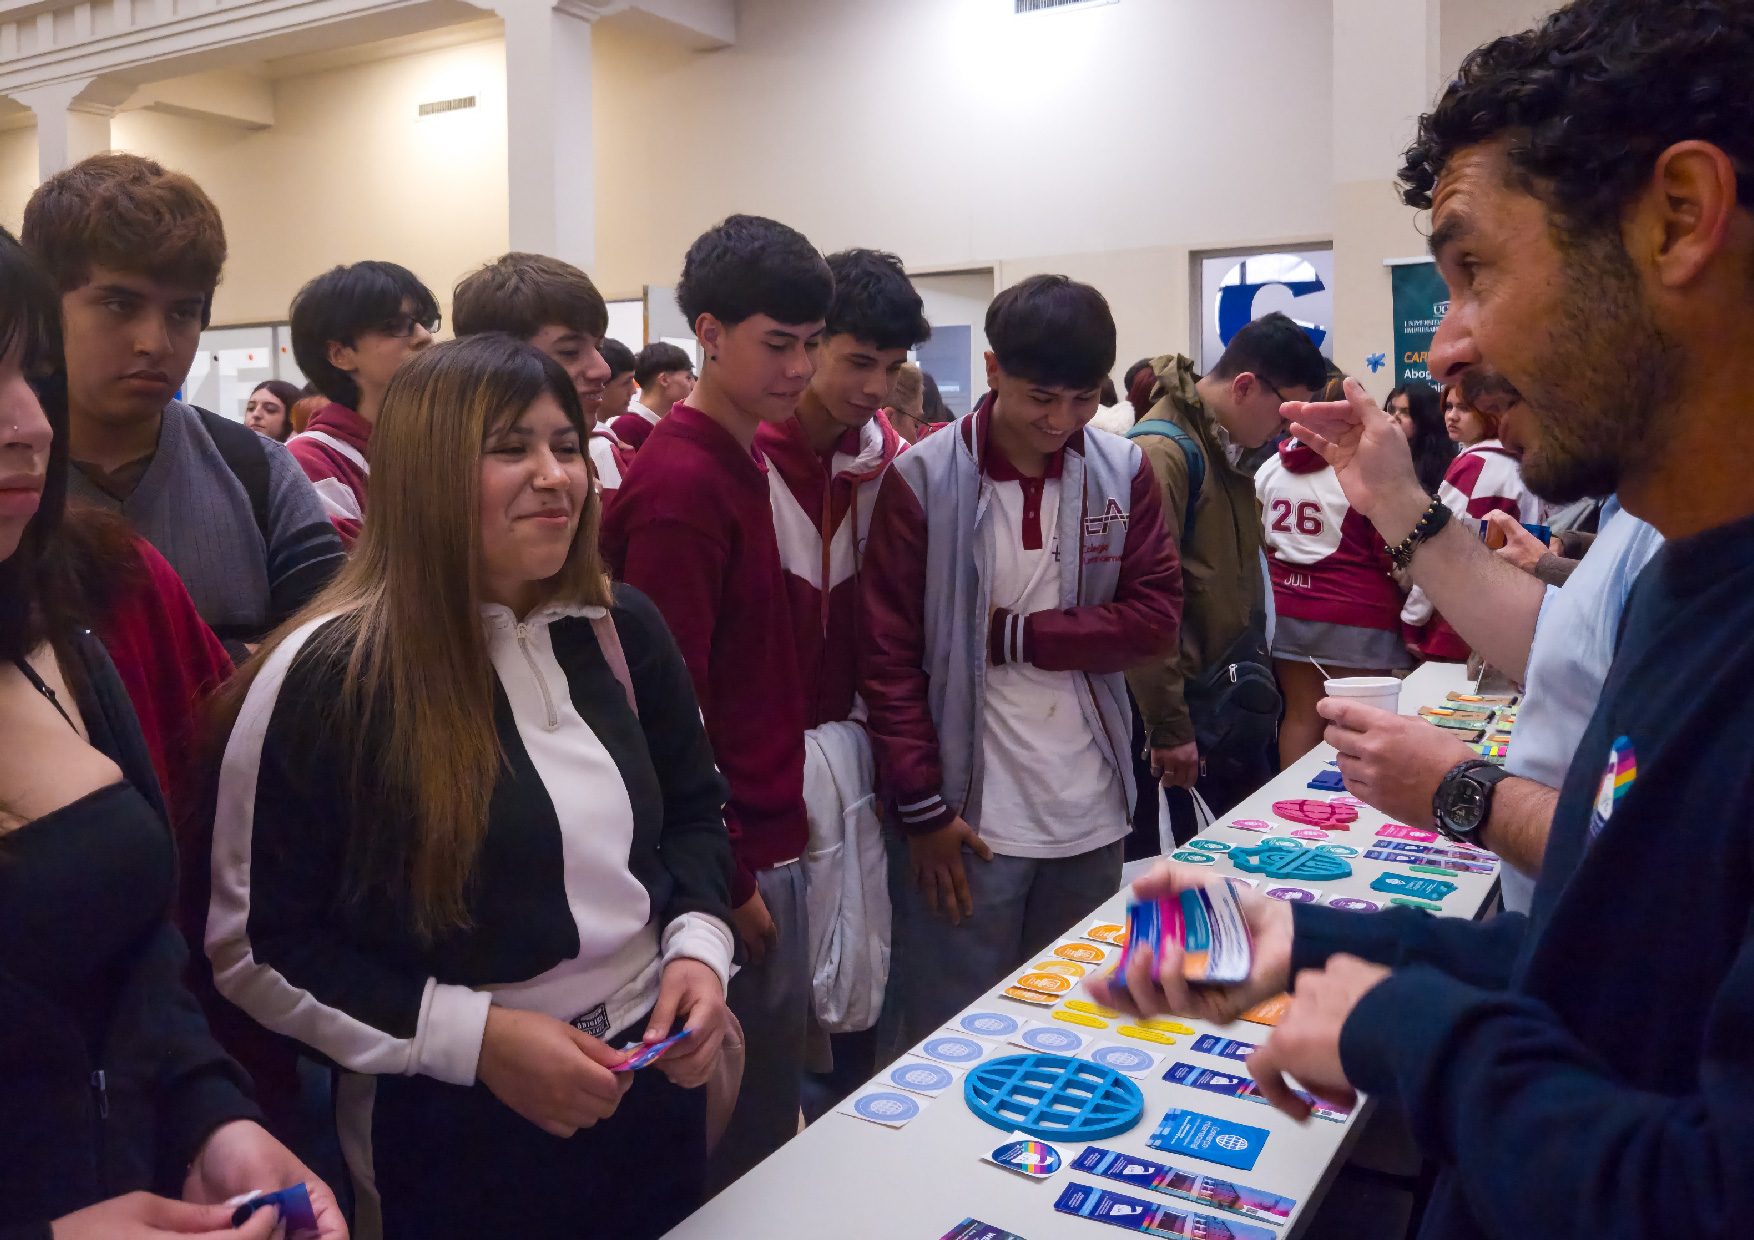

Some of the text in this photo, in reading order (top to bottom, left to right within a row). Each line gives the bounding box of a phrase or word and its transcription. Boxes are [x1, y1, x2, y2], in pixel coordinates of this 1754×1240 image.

[1404, 352, 1428, 363] CAR
[1270, 498, 1324, 535] 26
[1284, 573, 1311, 589] JULI
